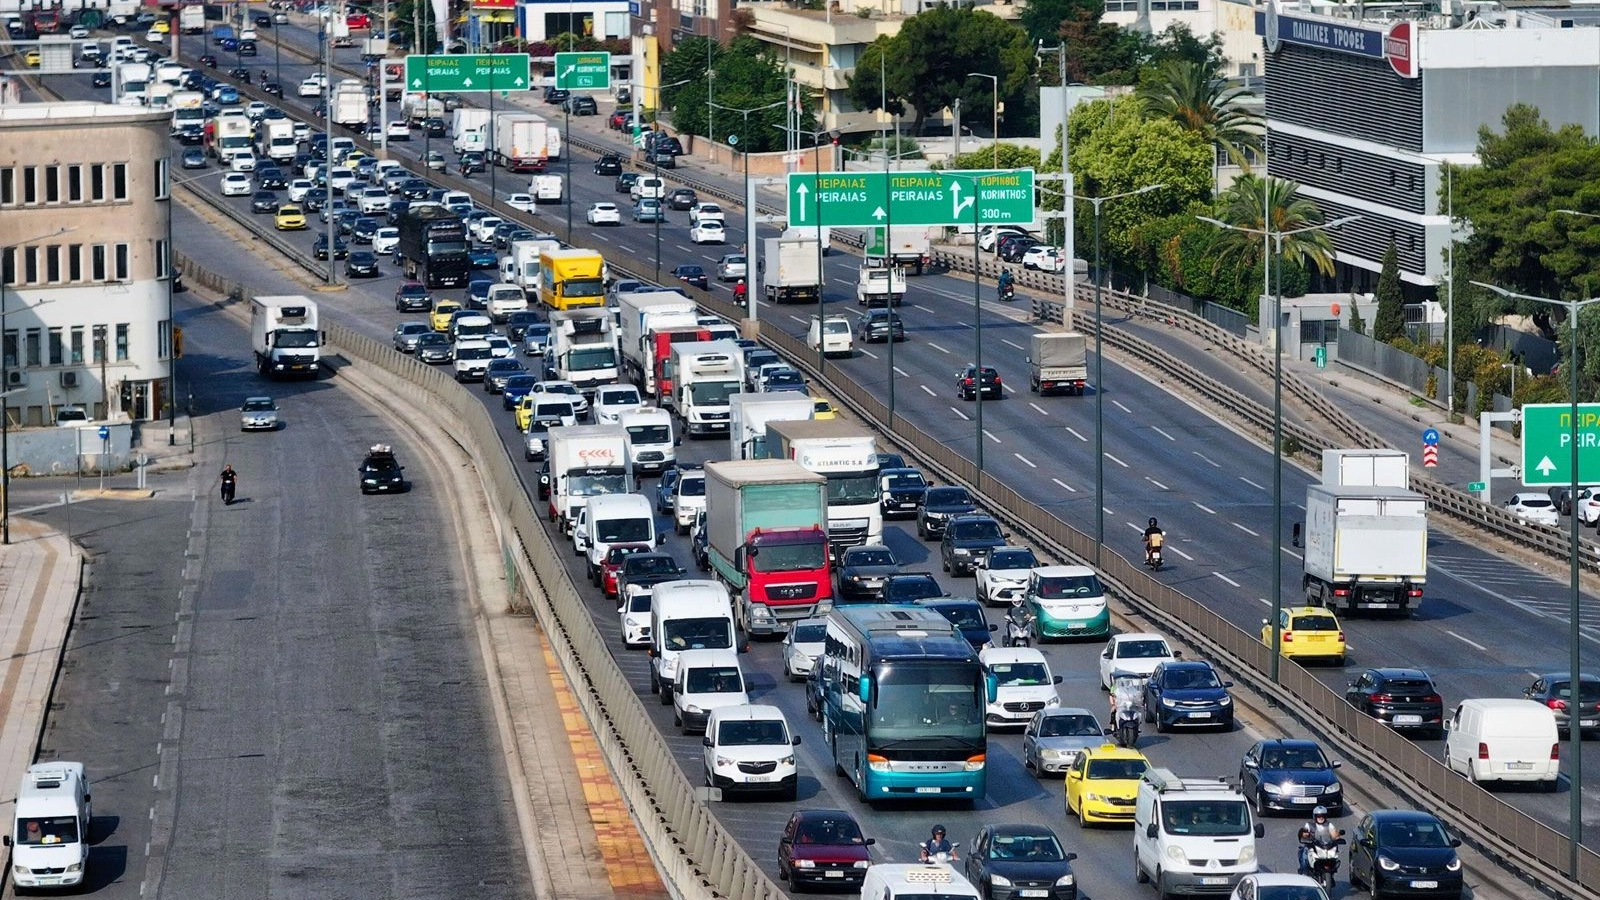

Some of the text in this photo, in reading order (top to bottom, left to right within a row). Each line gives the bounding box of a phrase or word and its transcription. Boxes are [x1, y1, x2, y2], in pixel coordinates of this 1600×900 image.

[1292, 21, 1365, 50] ΠΑΙΔΙΚΕΣ ΤΡΟΦΕΣ
[891, 177, 942, 188] ΠΕΙΡΑΙΑΣ
[981, 176, 1020, 186] ΚΟΡΙΝΘΟΣ
[891, 191, 943, 202] PEIRAIAS
[981, 189, 1027, 200] KORINTHOS
[981, 209, 1011, 219] 300 m
